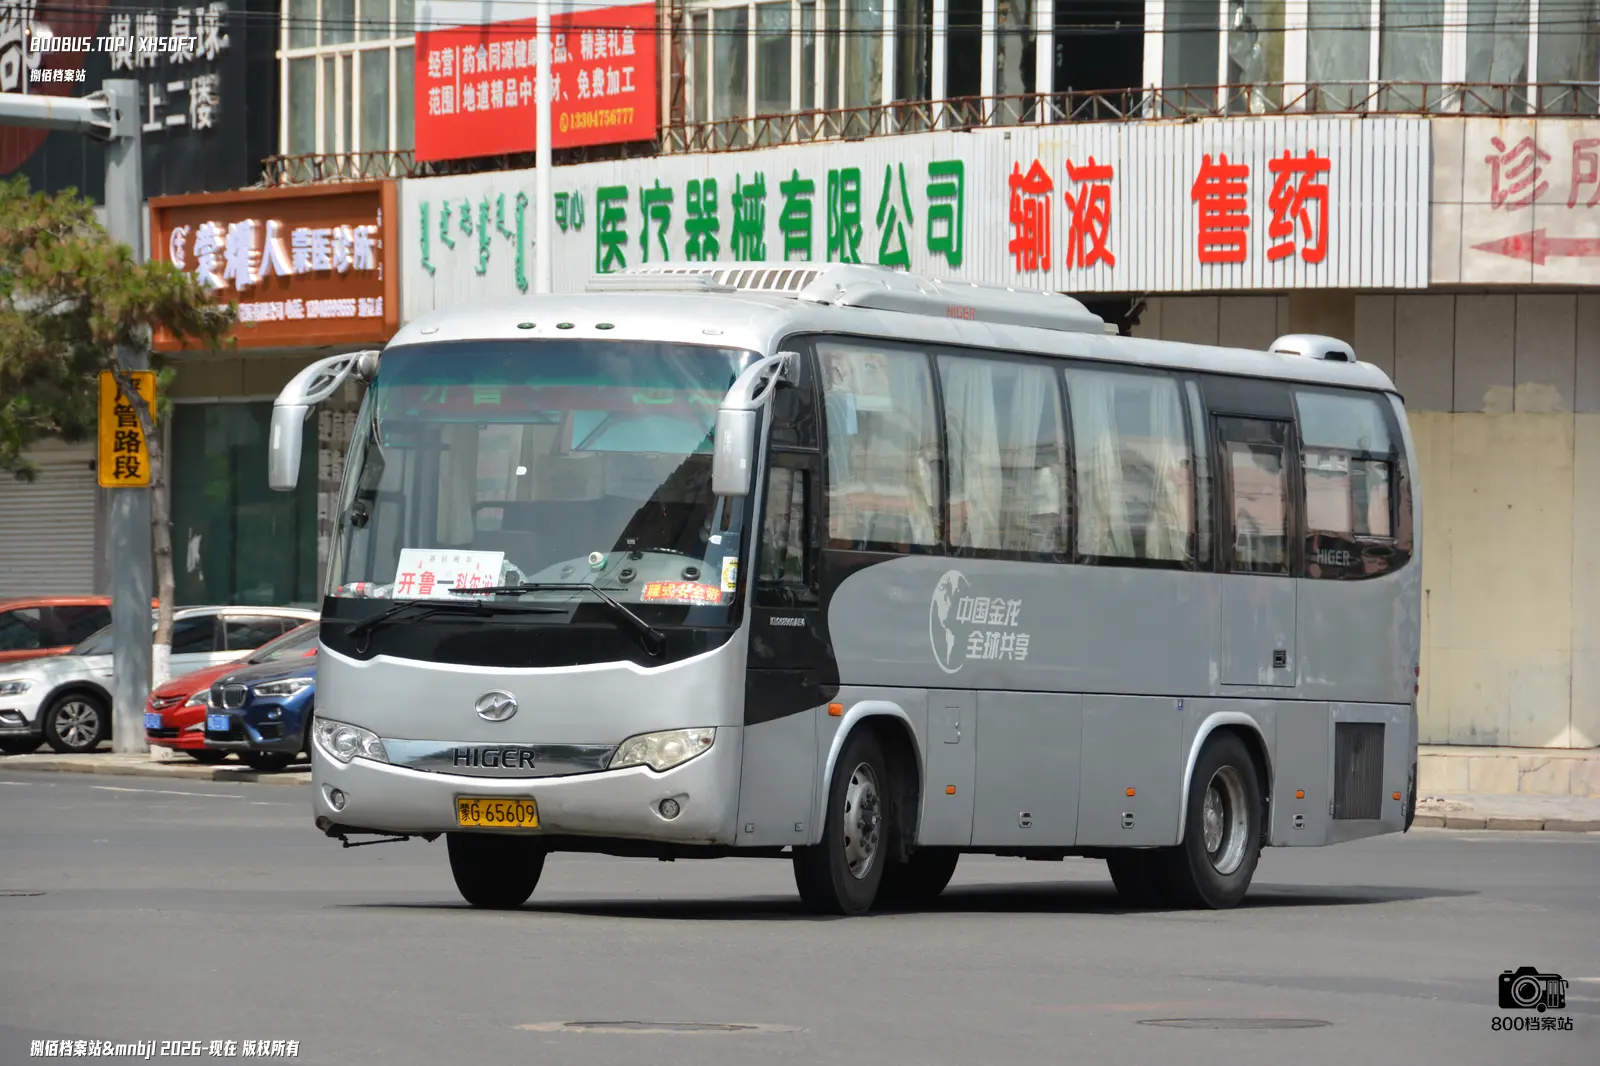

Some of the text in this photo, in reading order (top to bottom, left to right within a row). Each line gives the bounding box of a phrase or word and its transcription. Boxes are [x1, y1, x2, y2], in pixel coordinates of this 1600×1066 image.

[109, 3, 230, 71] 棋牌 桌球
[428, 46, 454, 79] 经营
[142, 76, 219, 132] 上二楼
[428, 66, 636, 116] 范围 地道精品中材、免费加工
[1008, 149, 1332, 273] 输液 售药
[946, 304, 977, 320] HIGER
[1316, 548, 1350, 566] HIGER
[956, 596, 1022, 626] 中国金龙
[966, 630, 1030, 660] 全球共享
[452, 747, 536, 769] HIGER
